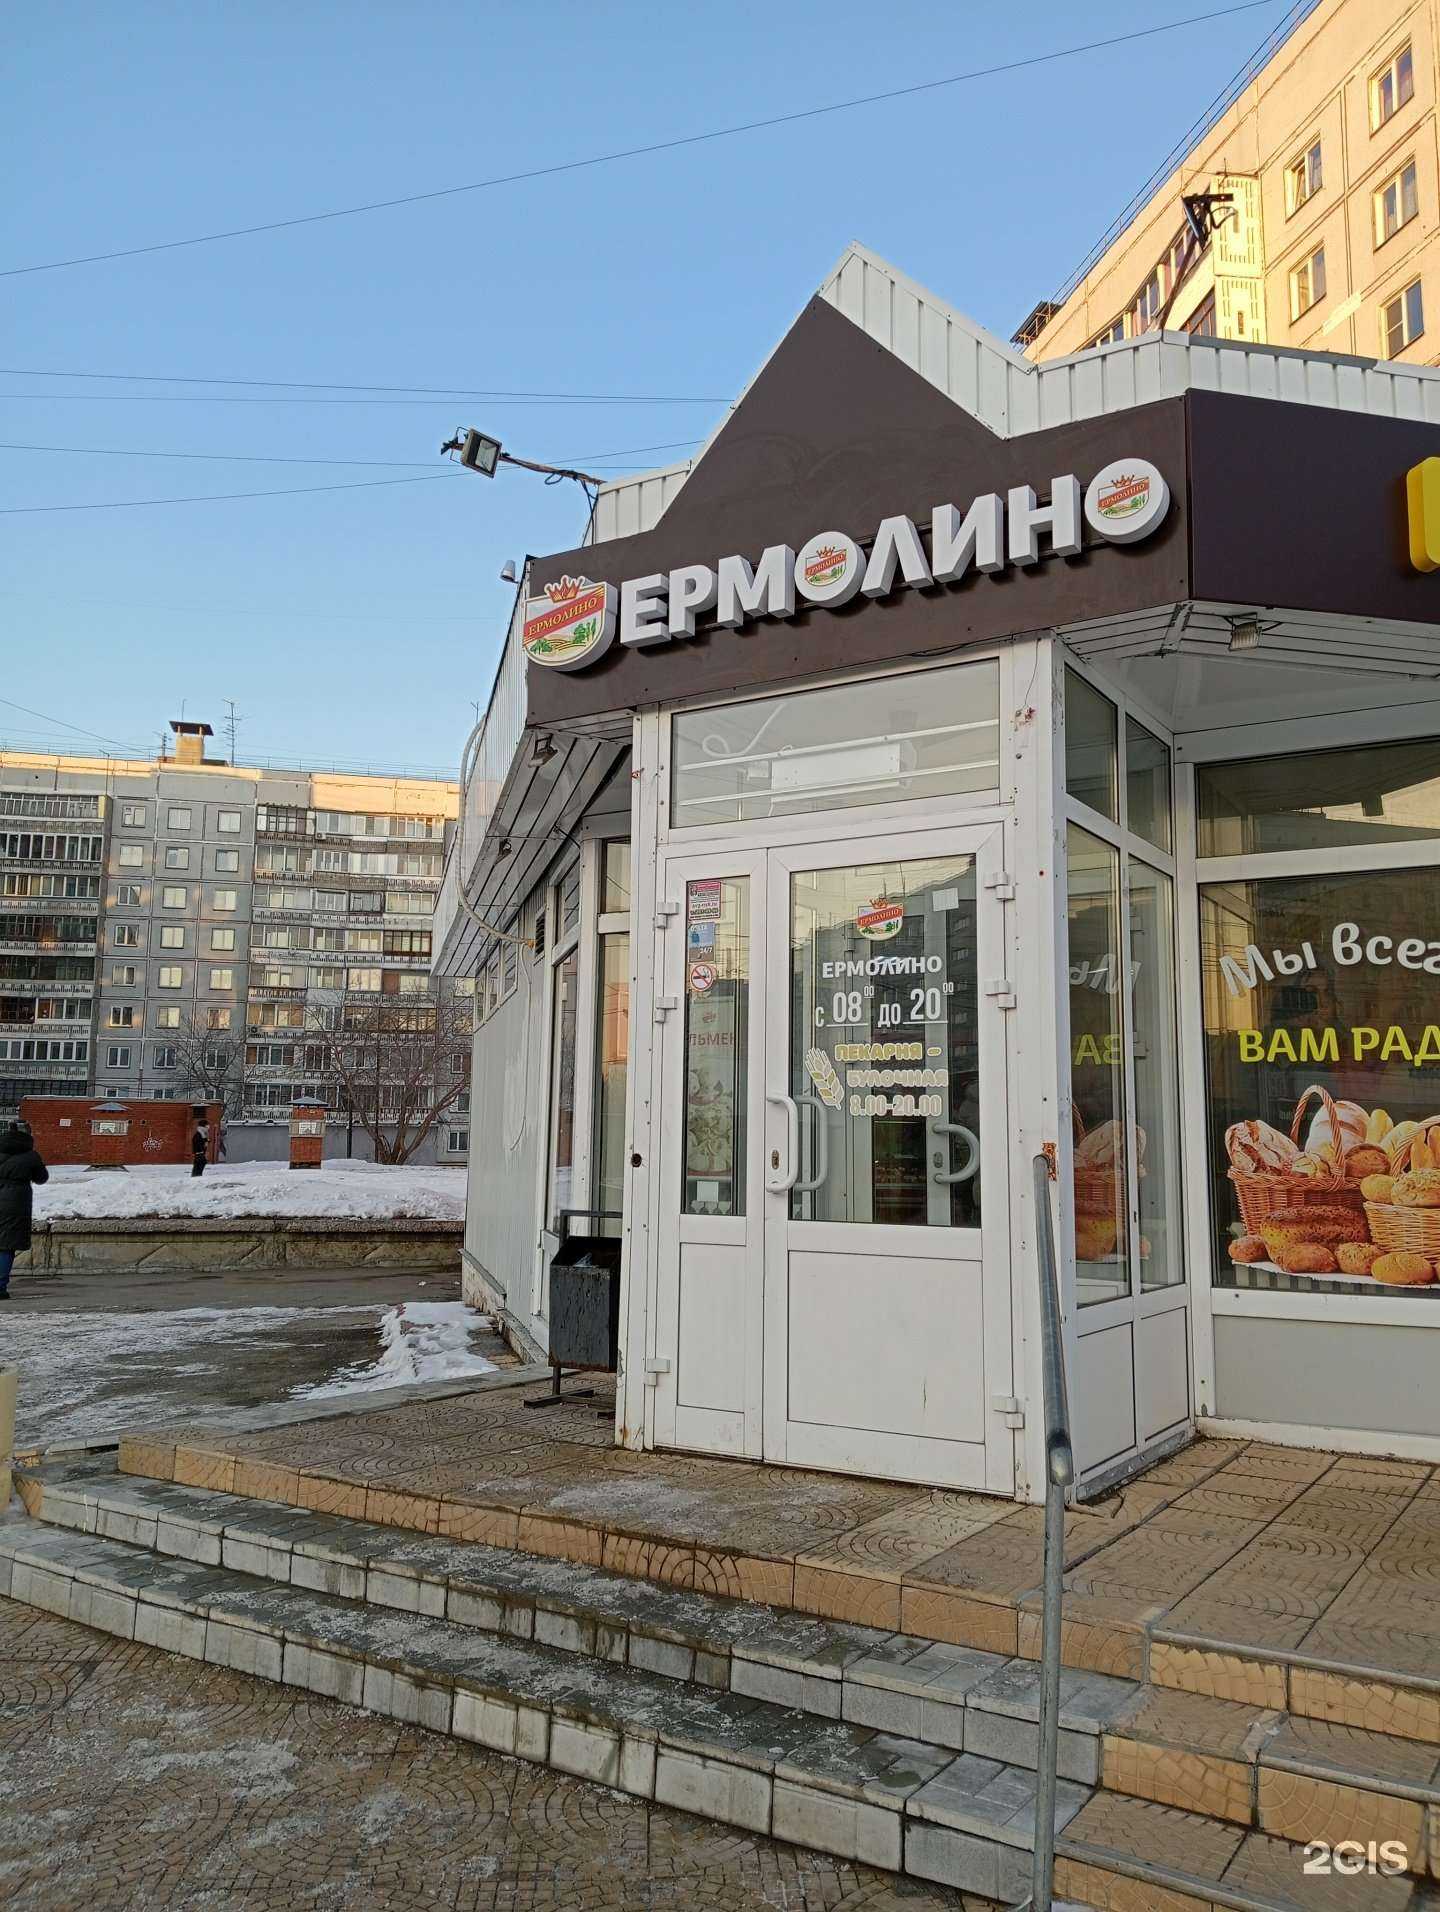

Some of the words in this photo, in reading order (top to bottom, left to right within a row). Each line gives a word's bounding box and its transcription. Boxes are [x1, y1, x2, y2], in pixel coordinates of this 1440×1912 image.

[620, 458, 1172, 648] ЕРМОЛИНО
[528, 597, 597, 636] ЕРМОЛИНО
[822, 955, 943, 979] ЕРМОЛИНО
[1219, 942, 1317, 997] Мы
[834, 1042, 923, 1062] ПЕКАРНЯ
[1237, 1026, 1341, 1063] ВАМ
[847, 1068, 949, 1088] БУЛОЧНАЯ
[849, 1094, 943, 1117] 8.00-20.00
